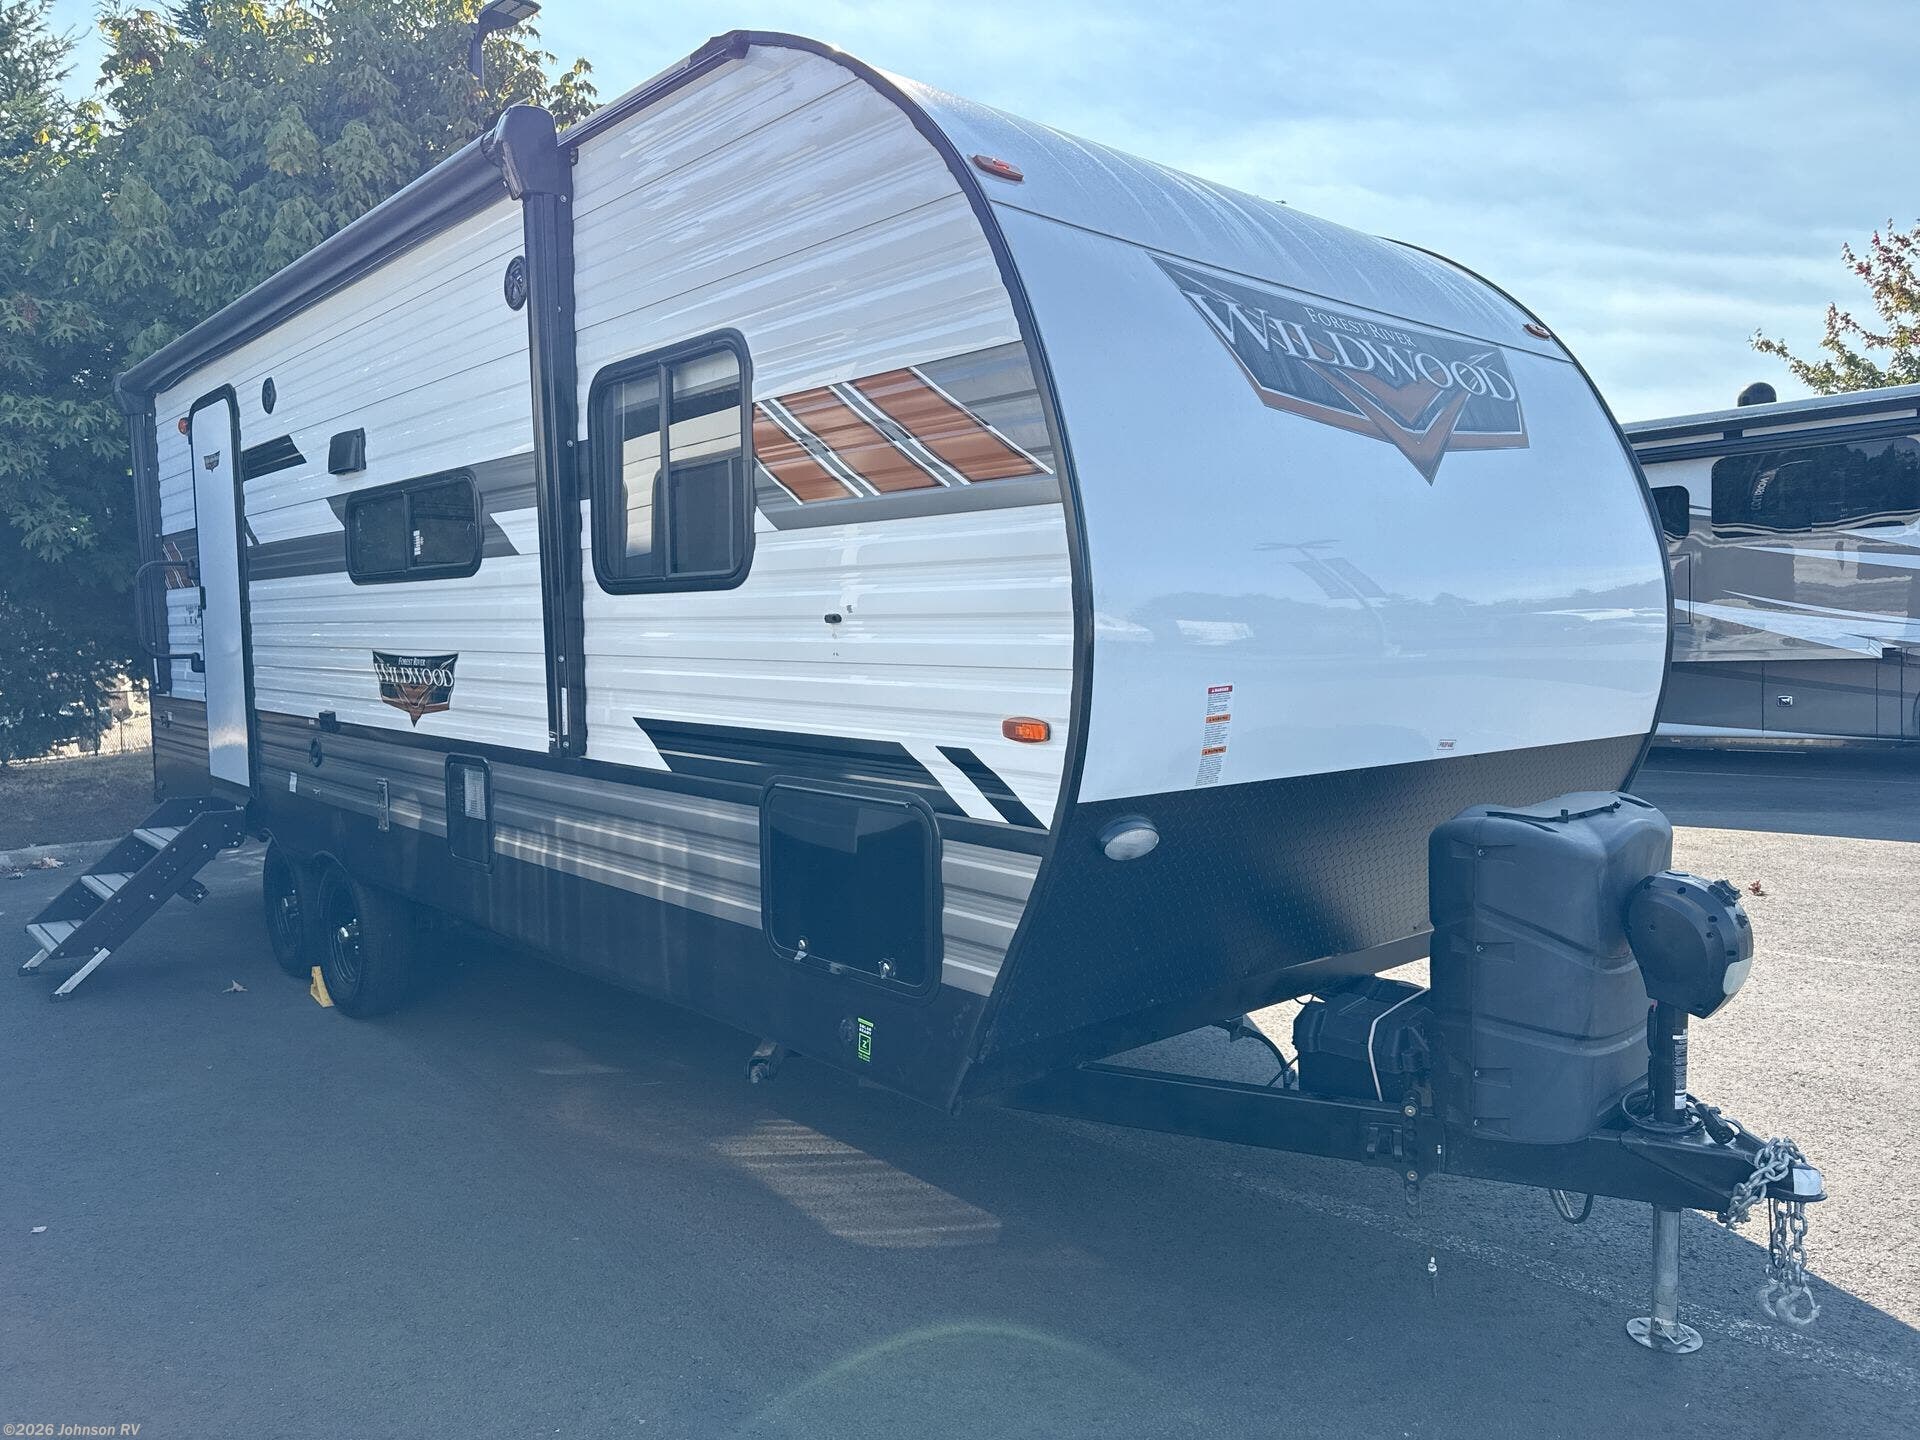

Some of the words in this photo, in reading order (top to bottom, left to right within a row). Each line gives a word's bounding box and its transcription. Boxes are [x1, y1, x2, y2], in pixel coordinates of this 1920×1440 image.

[1180, 288, 1516, 402] WILDWOOD
[1303, 306, 1368, 336] FOREST
[1368, 322, 1417, 349] RIVER
[374, 663, 454, 688] WILDWOOD
